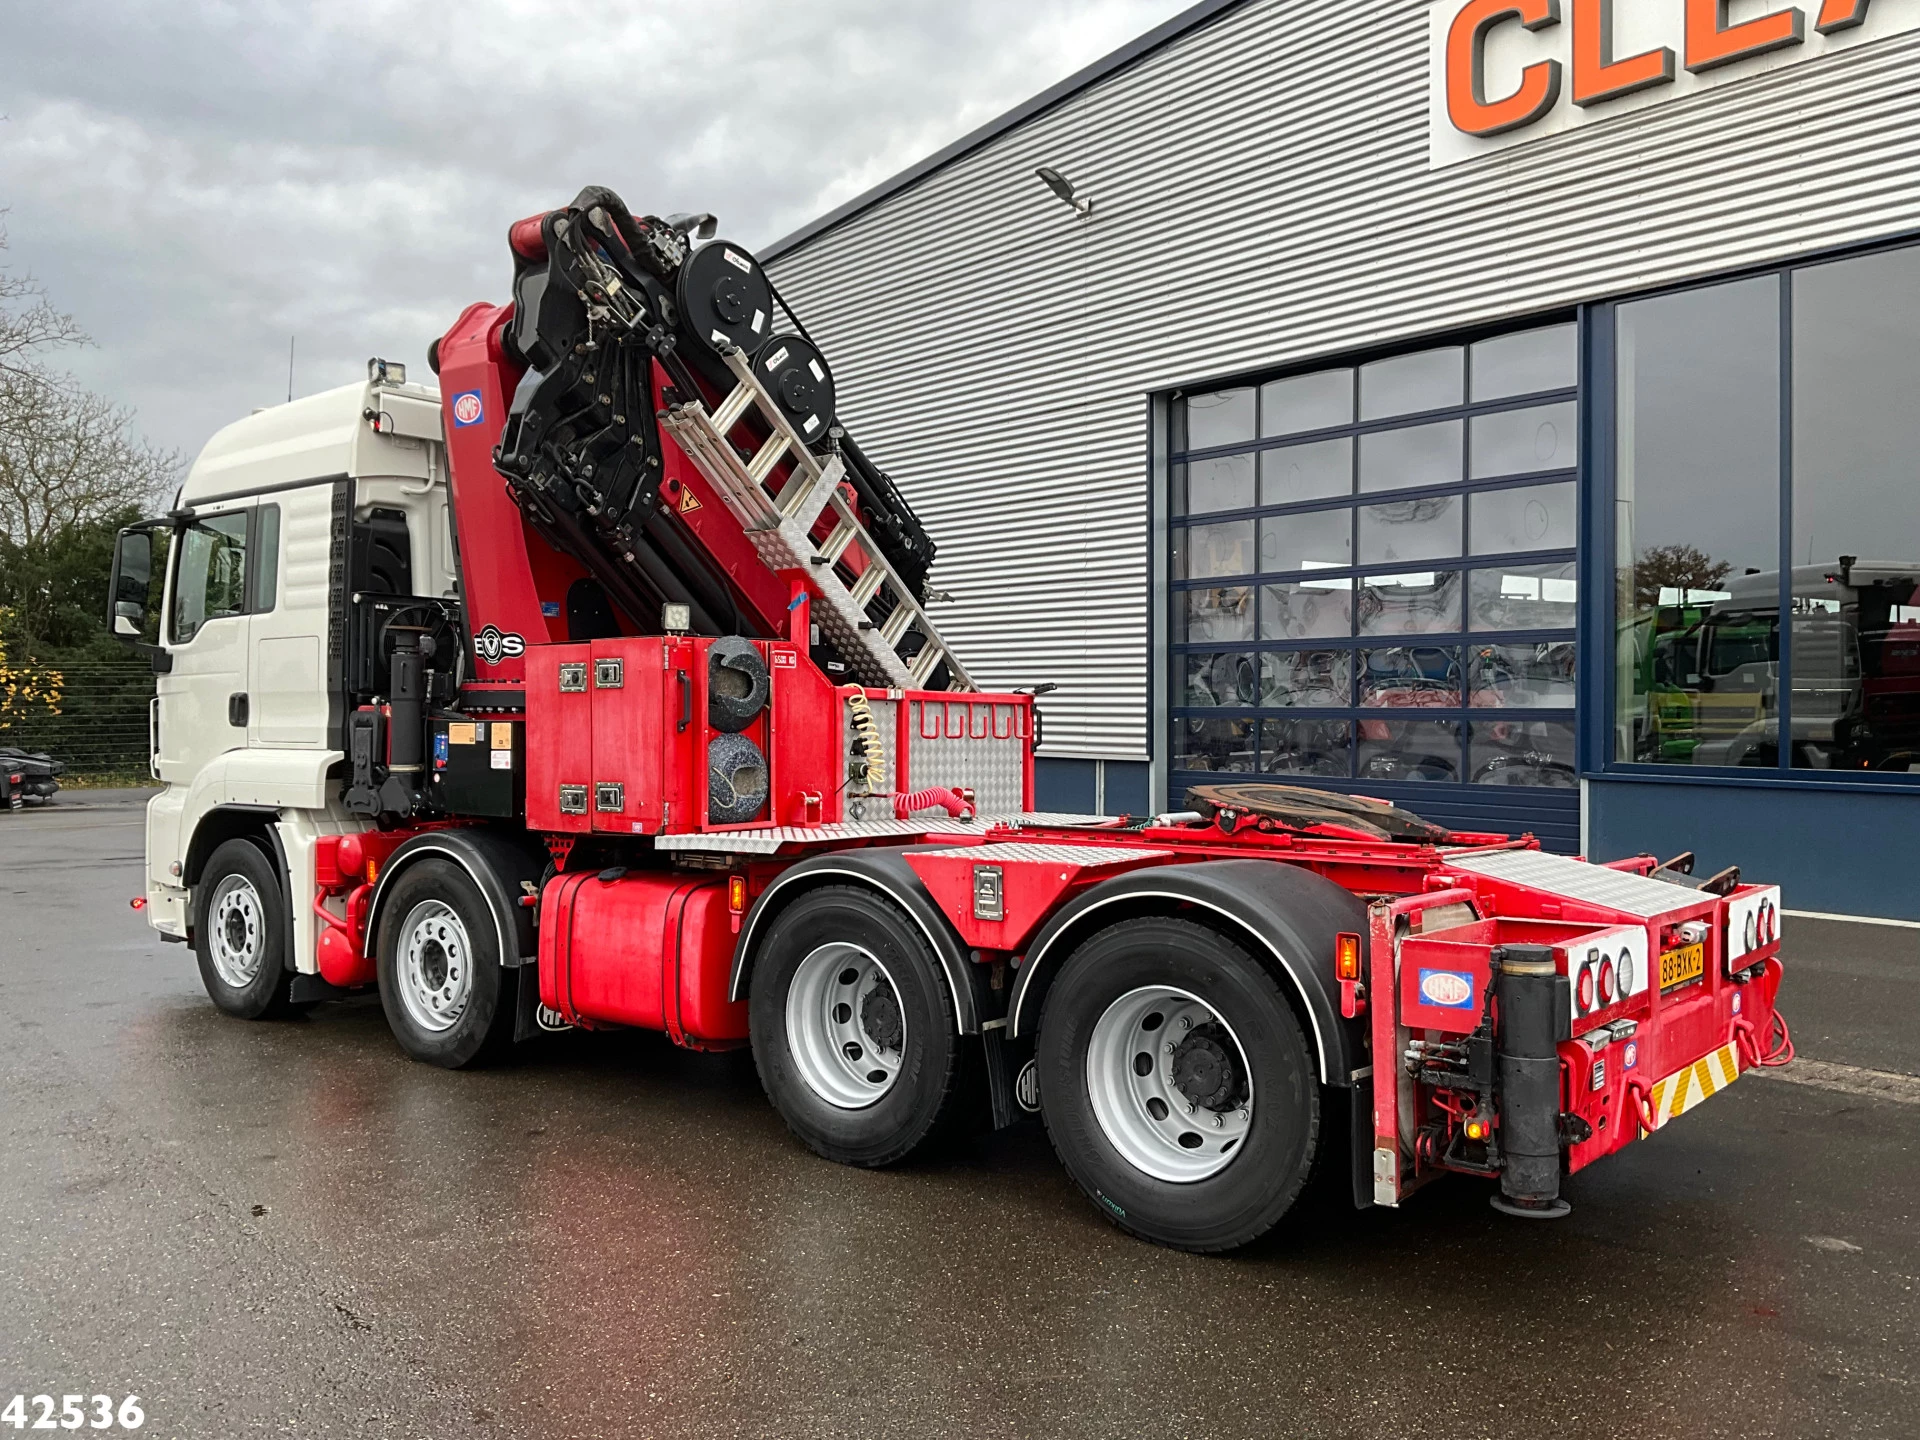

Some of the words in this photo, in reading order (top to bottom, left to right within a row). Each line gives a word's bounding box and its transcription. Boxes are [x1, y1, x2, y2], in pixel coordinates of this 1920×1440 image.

[458, 397, 478, 420] HMF
[1662, 948, 1701, 983] 88-BXK-2
[1427, 976, 1467, 1001] HMF
